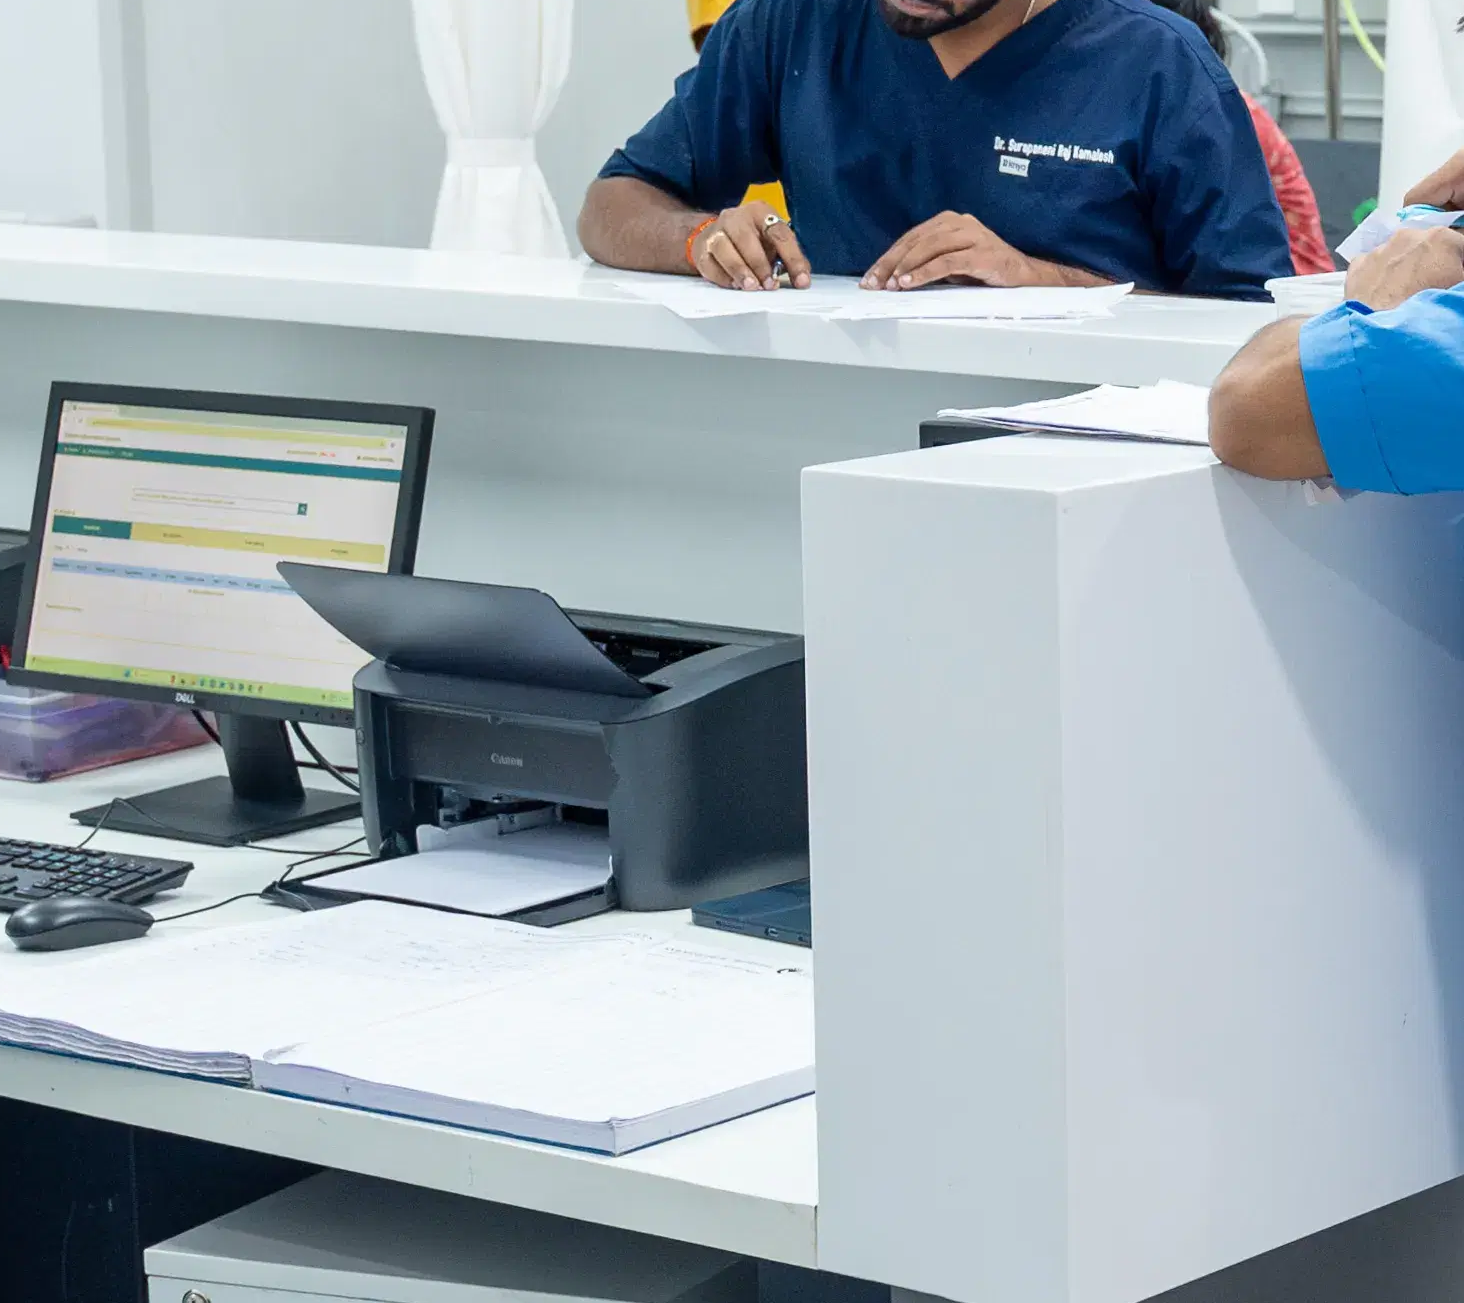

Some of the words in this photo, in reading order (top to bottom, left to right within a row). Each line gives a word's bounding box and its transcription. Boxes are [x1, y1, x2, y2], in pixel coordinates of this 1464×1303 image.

[994, 136, 1006, 151] Dr.
[1008, 138, 1056, 156] Surapaneni
[1057, 144, 1072, 161] Raj
[1073, 145, 1114, 164] Kamalesh
[175, 692, 196, 704] DELL
